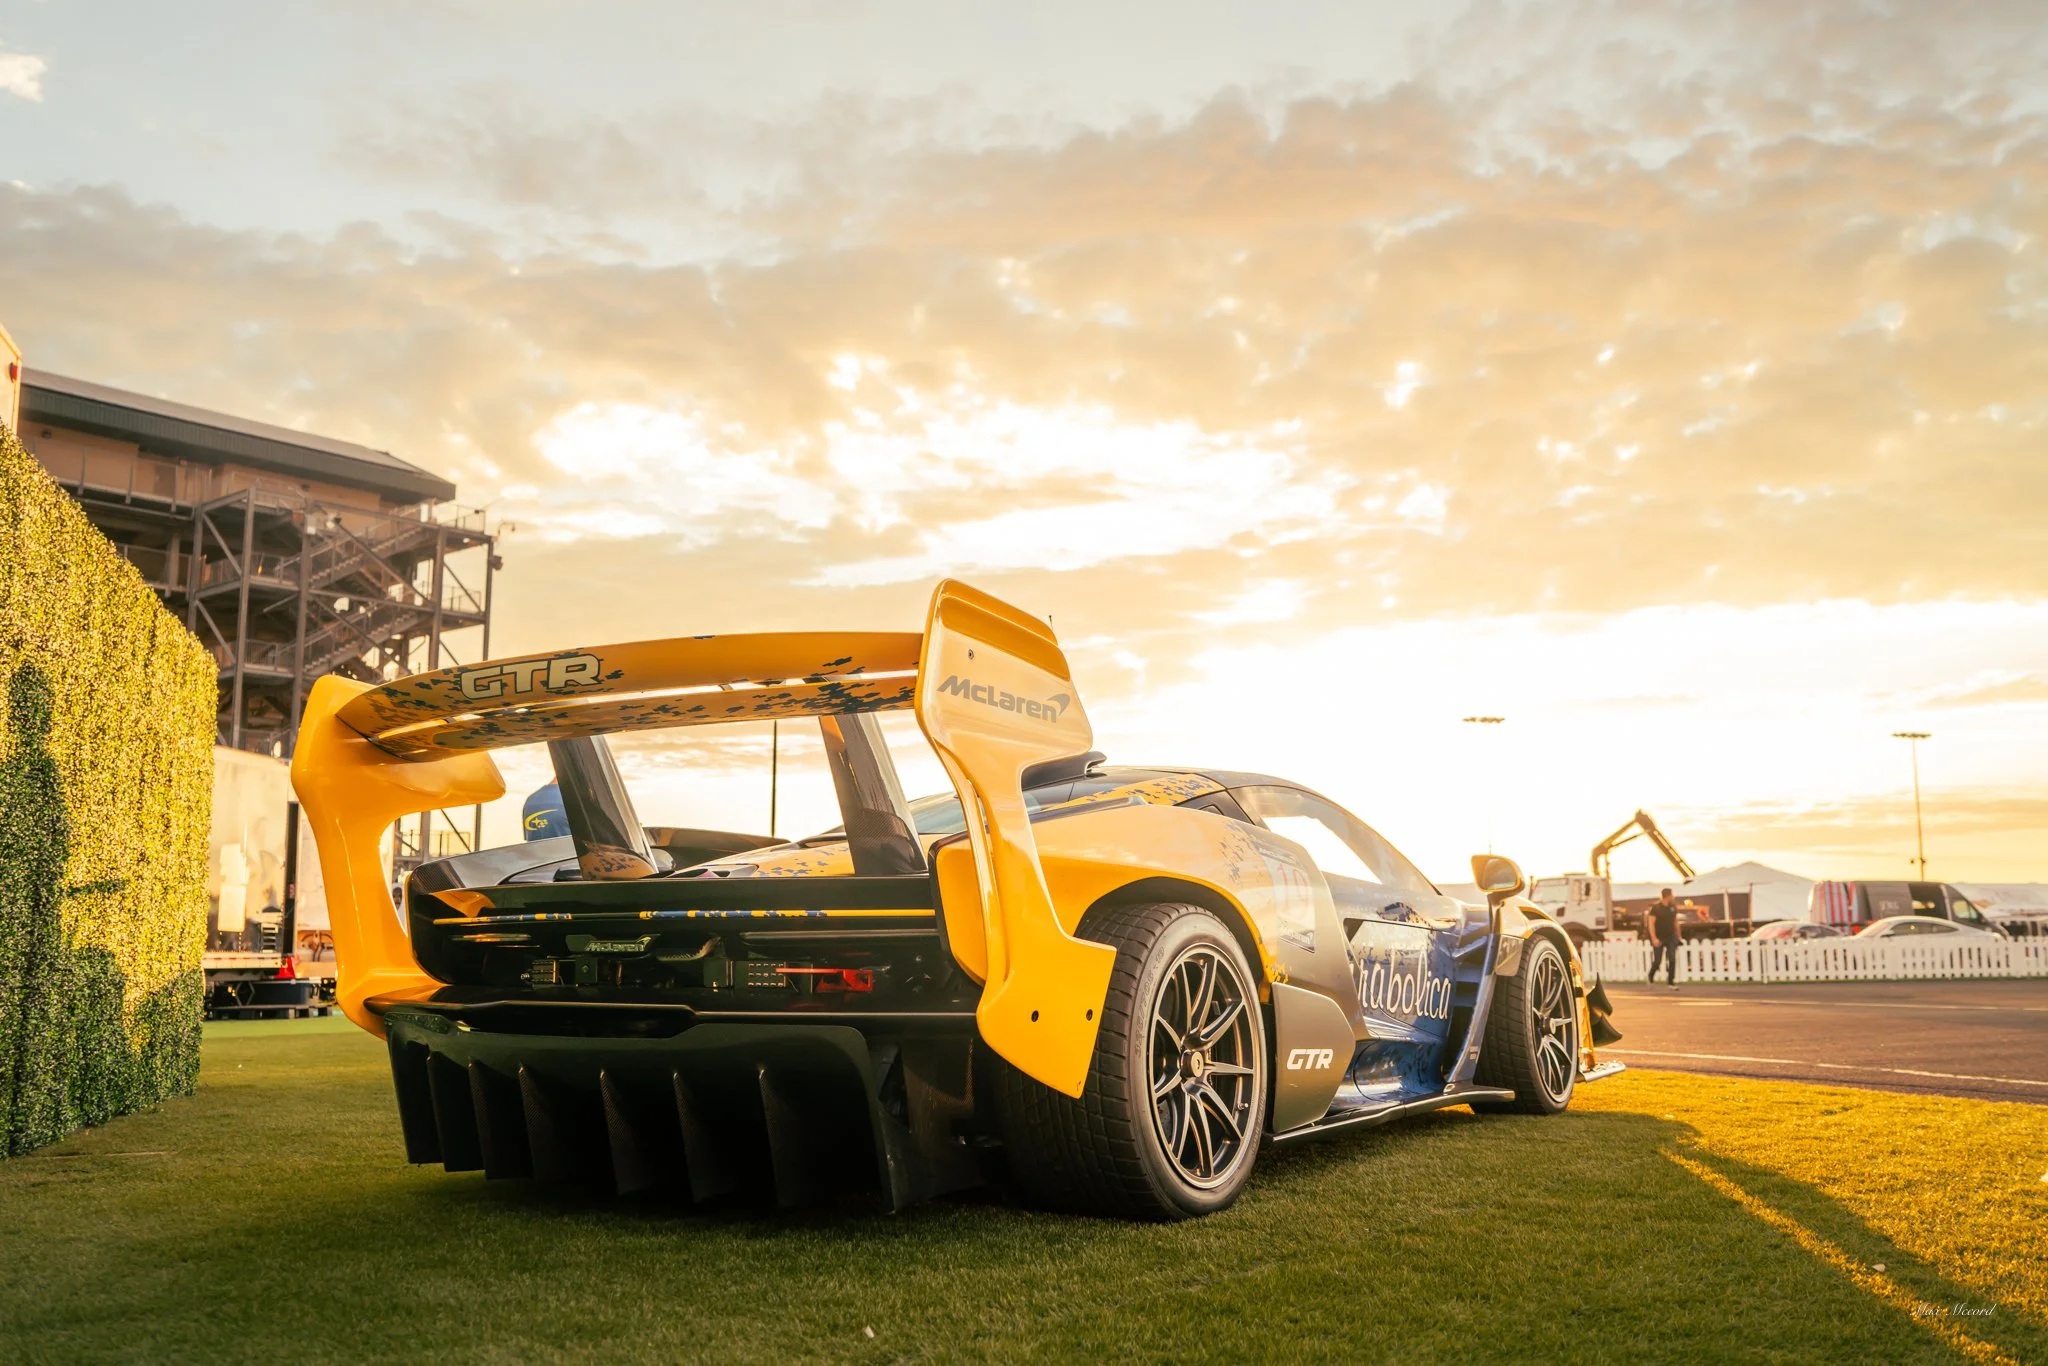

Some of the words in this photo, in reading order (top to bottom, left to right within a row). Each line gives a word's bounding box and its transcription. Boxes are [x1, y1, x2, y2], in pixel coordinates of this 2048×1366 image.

[460, 653, 601, 700] GTR
[937, 675, 1058, 723] McLaren
[585, 941, 646, 952] McLaren
[1349, 946, 1452, 1020] rabolica
[1286, 1048, 1334, 1070] GTR
